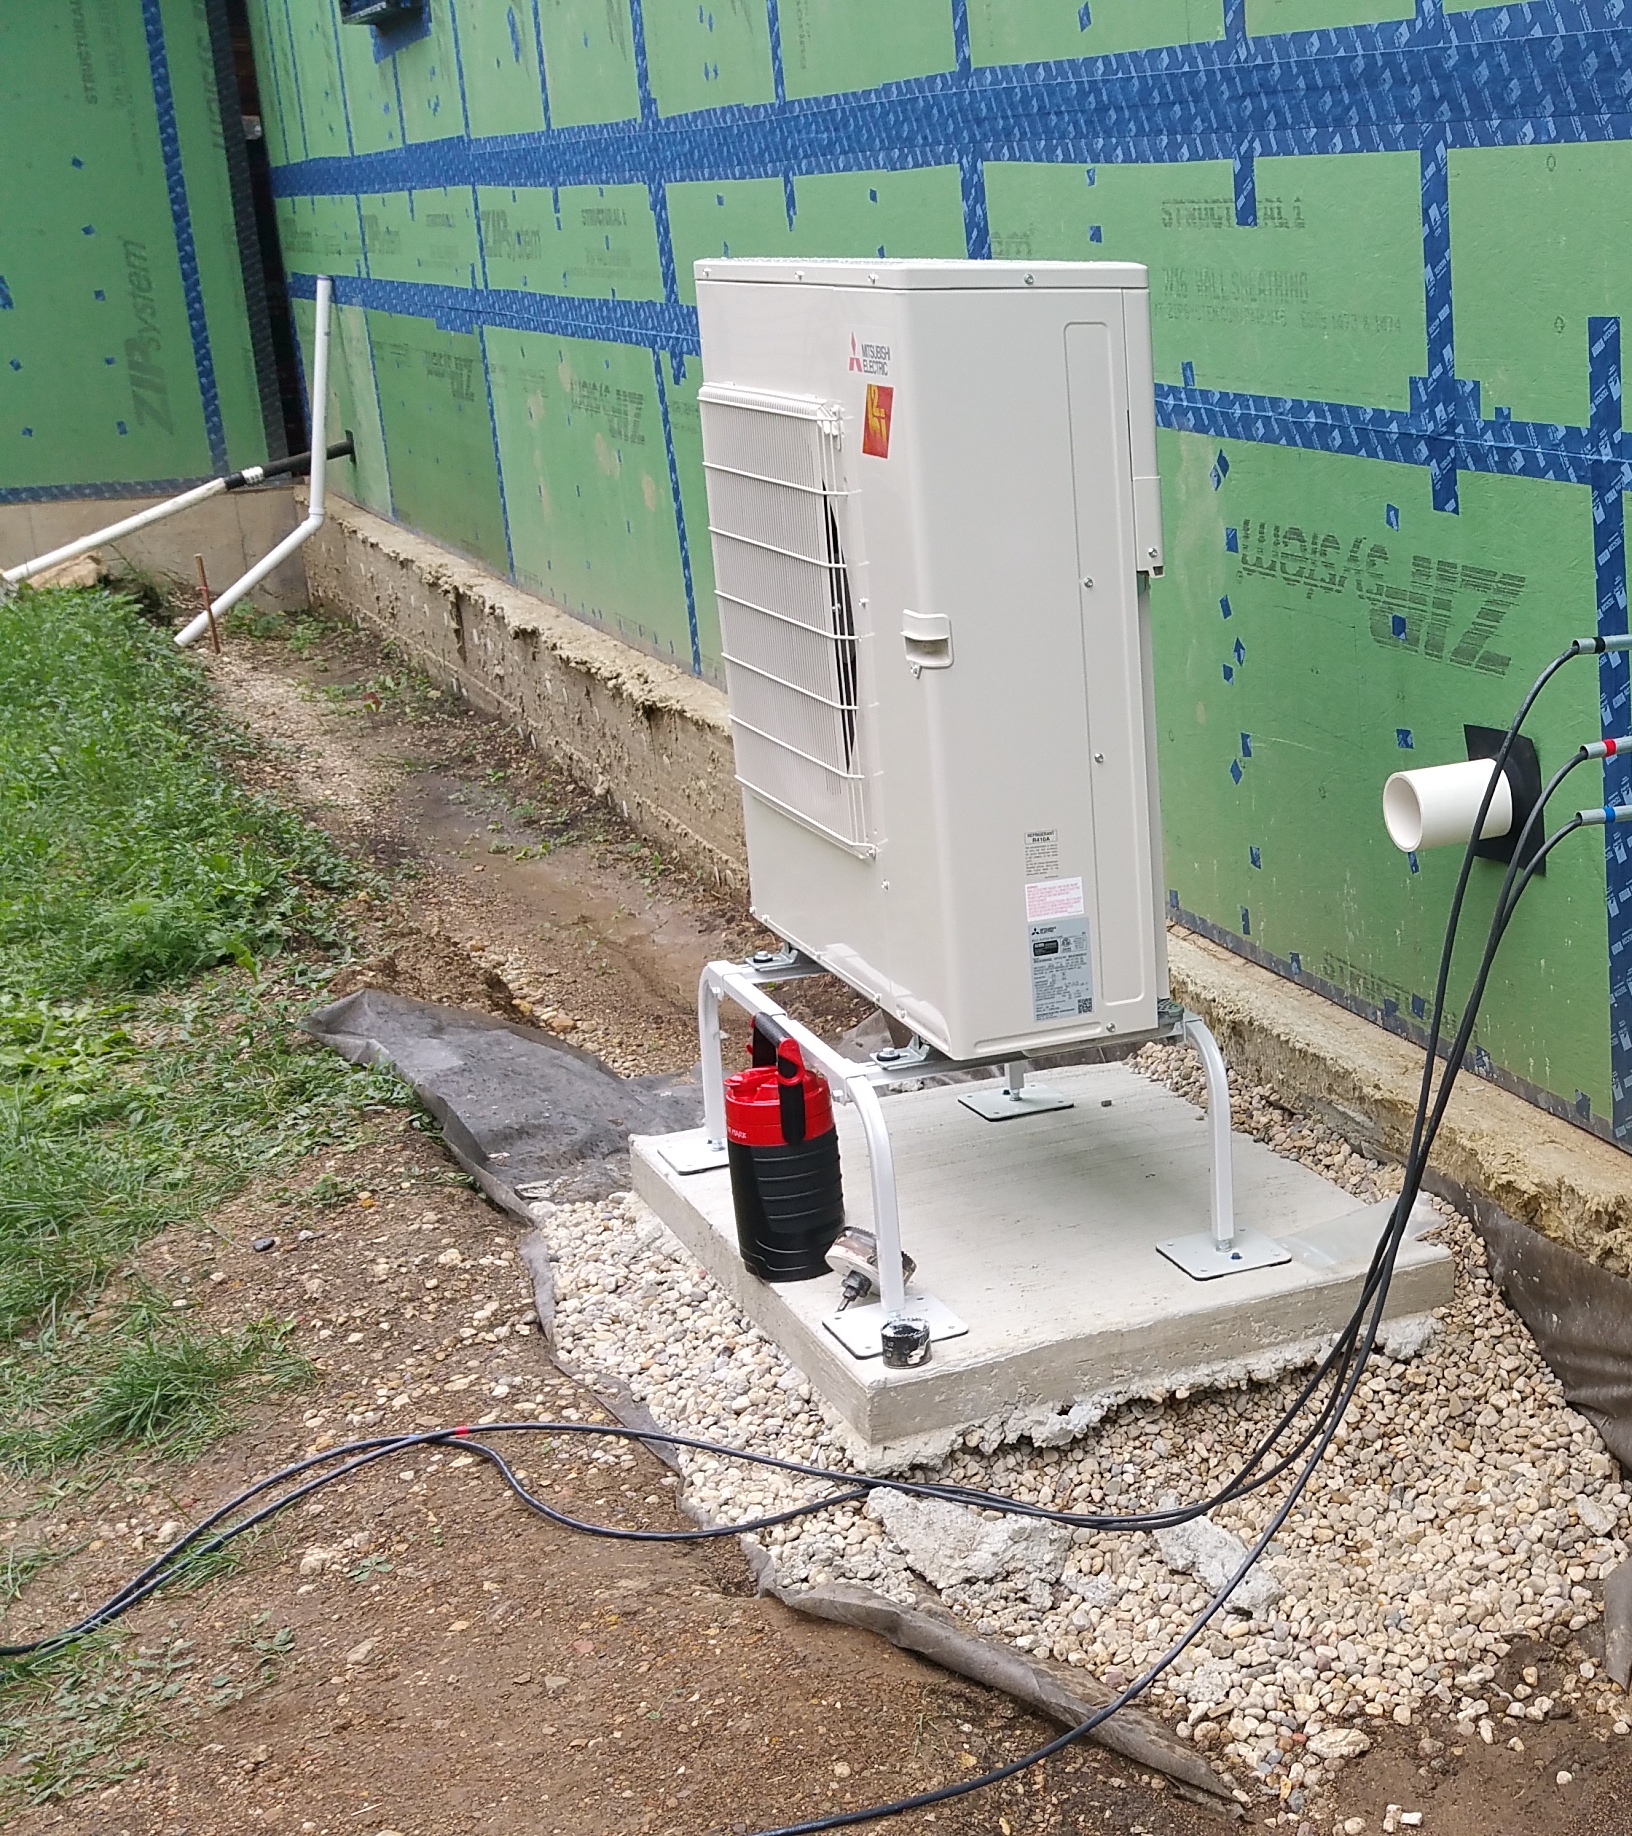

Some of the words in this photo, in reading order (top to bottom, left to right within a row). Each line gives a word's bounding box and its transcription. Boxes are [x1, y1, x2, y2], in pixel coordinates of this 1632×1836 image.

[1161, 197, 1290, 229] STRUCTAL
[861, 343, 891, 361] MITSUBISHI
[863, 359, 889, 376] ELECTRIC
